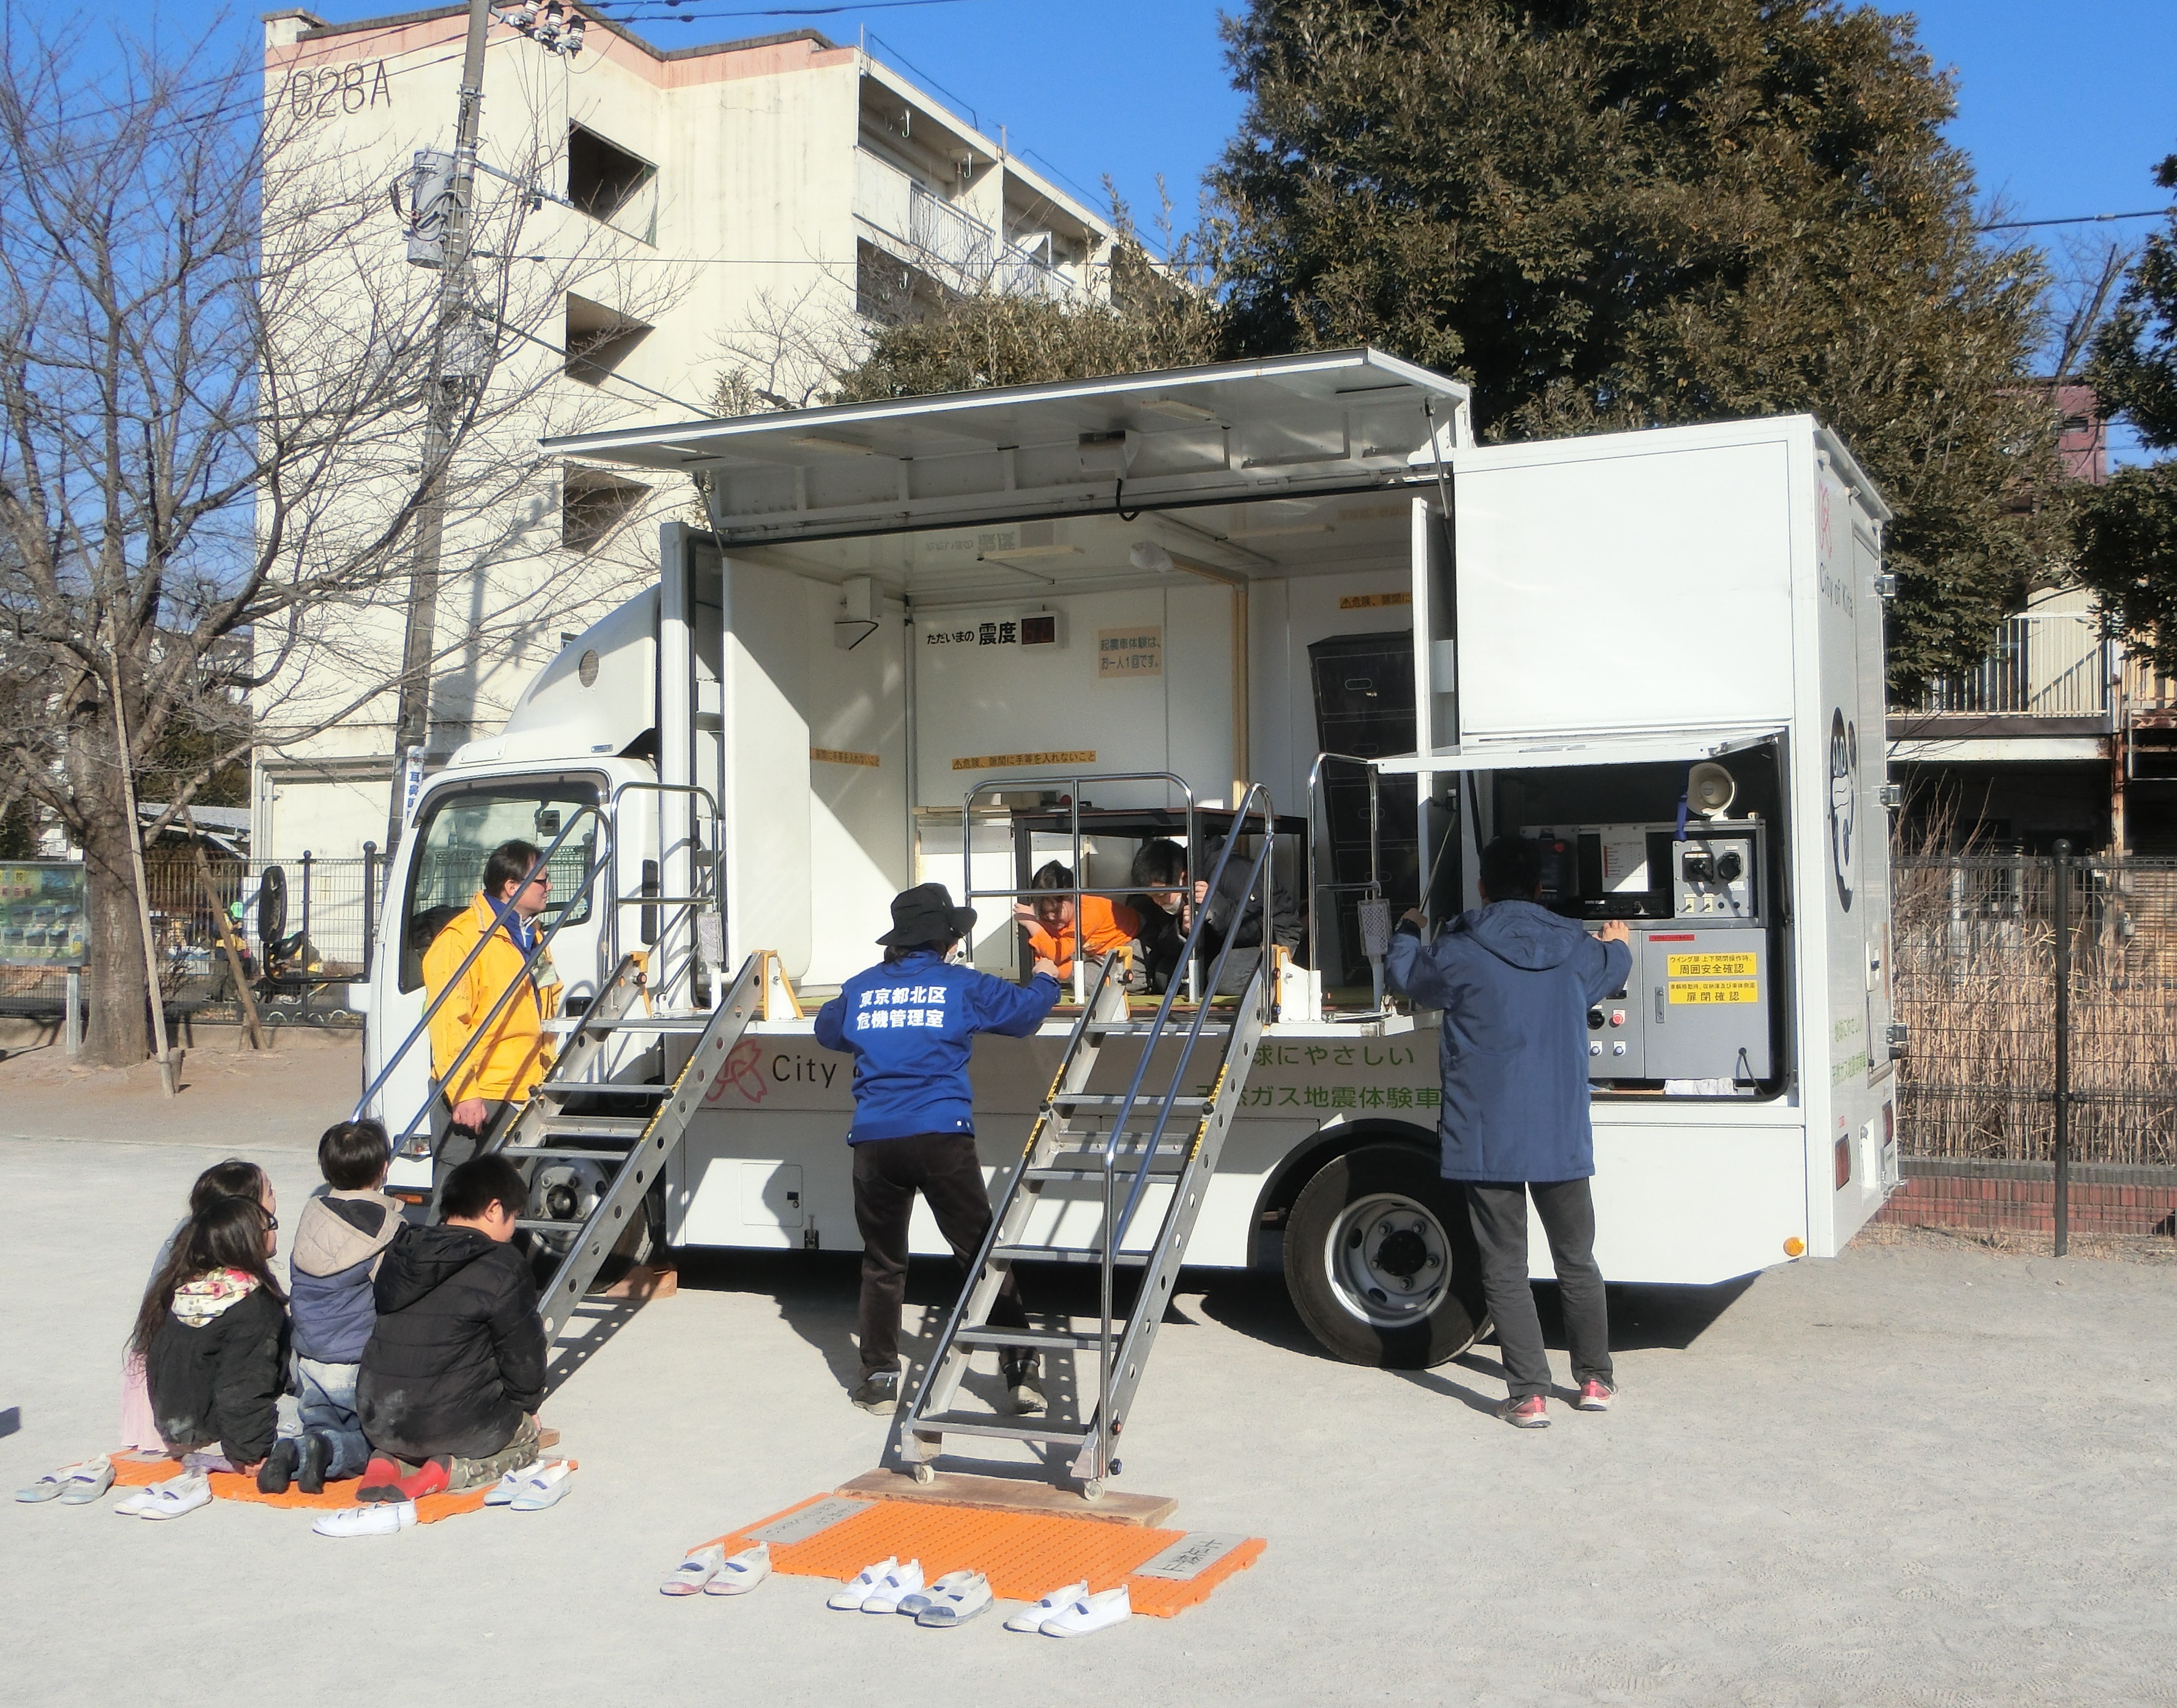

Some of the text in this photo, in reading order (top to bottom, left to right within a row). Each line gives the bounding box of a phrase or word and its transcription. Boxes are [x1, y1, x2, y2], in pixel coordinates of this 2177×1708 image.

[1680, 964, 1745, 975] 周囲安全確認
[859, 986, 947, 1009] 東京都北区
[856, 1009, 944, 1031] 危機管理室
[1220, 1045, 1414, 1066] 球にやさしい
[772, 1055, 837, 1088] City
